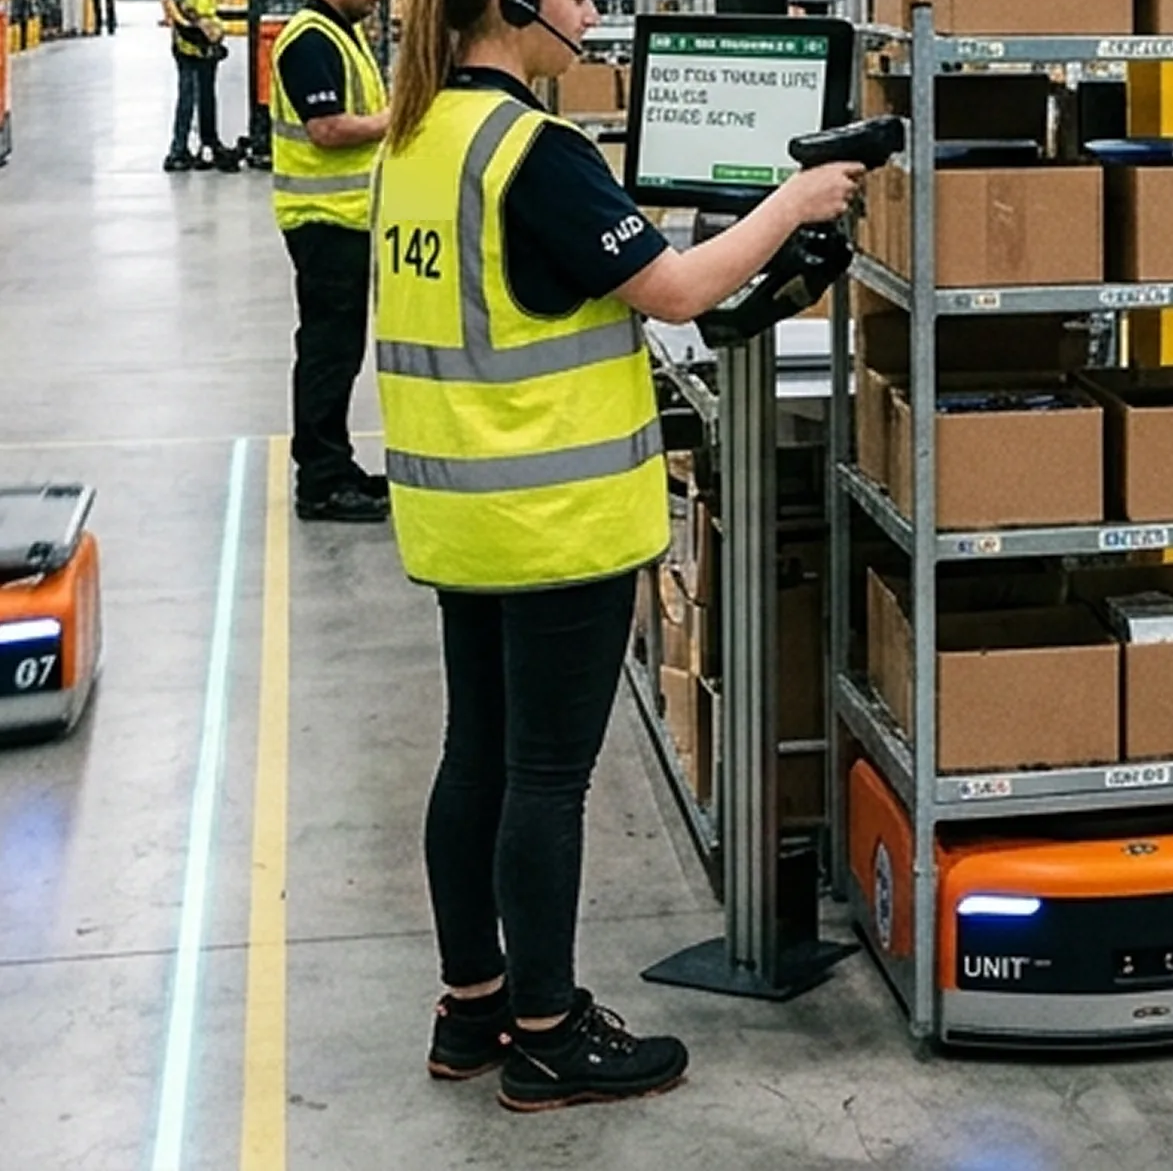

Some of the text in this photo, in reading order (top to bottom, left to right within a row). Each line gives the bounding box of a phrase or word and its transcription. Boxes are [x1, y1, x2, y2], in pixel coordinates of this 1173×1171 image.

[385, 225, 441, 280] 142
[14, 654, 57, 690] 07
[964, 955, 1029, 980] UNIT
